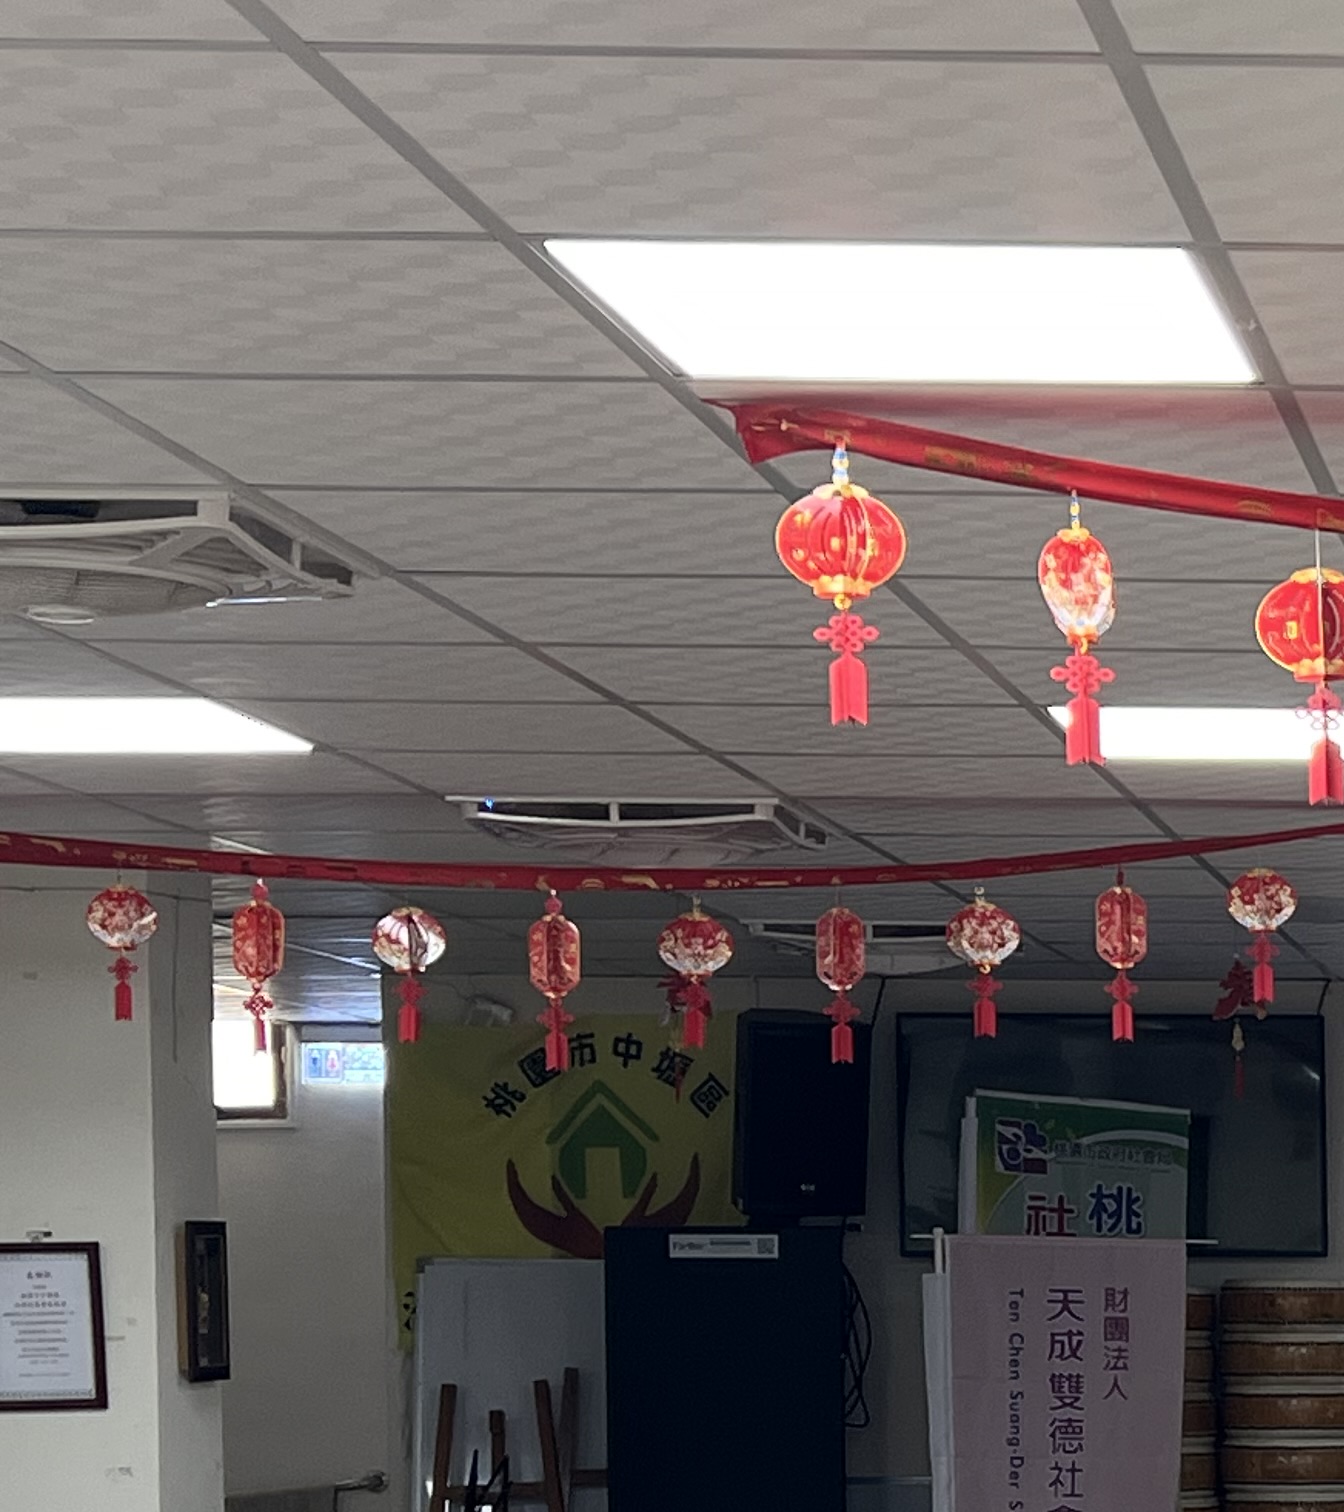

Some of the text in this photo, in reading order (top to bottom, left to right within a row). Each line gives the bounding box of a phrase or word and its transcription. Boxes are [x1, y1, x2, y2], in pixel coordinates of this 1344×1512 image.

[1025, 1194, 1078, 1237] 社
[1088, 1183, 1143, 1236] 桃
[1008, 1332, 1025, 1380] Chen
[1103, 1287, 1130, 1401] 財團法人
